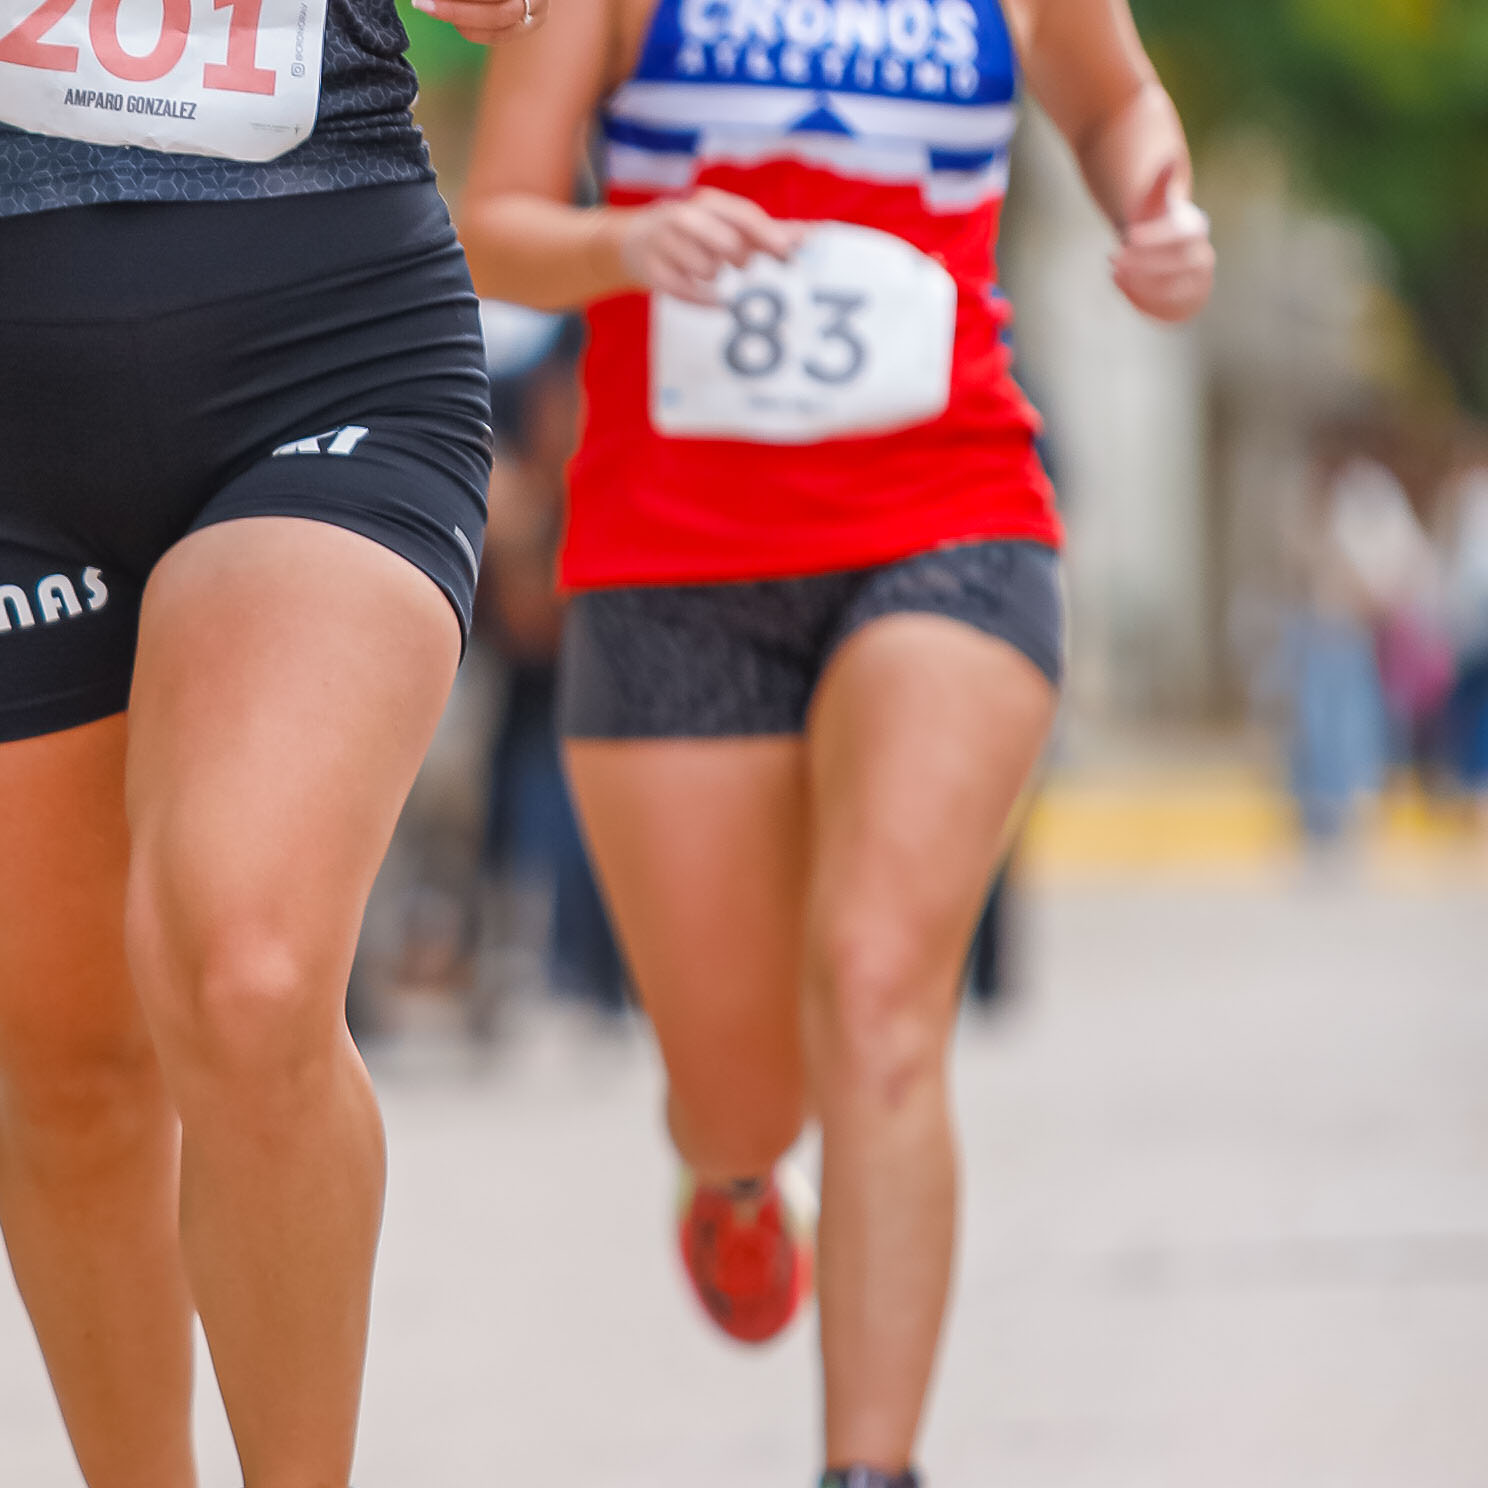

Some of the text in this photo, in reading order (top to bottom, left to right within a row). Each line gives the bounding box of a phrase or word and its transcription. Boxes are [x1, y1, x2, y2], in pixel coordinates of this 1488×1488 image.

[64, 88, 197, 120] AMPARO GONZALEZ
[724, 287, 866, 384] 83
